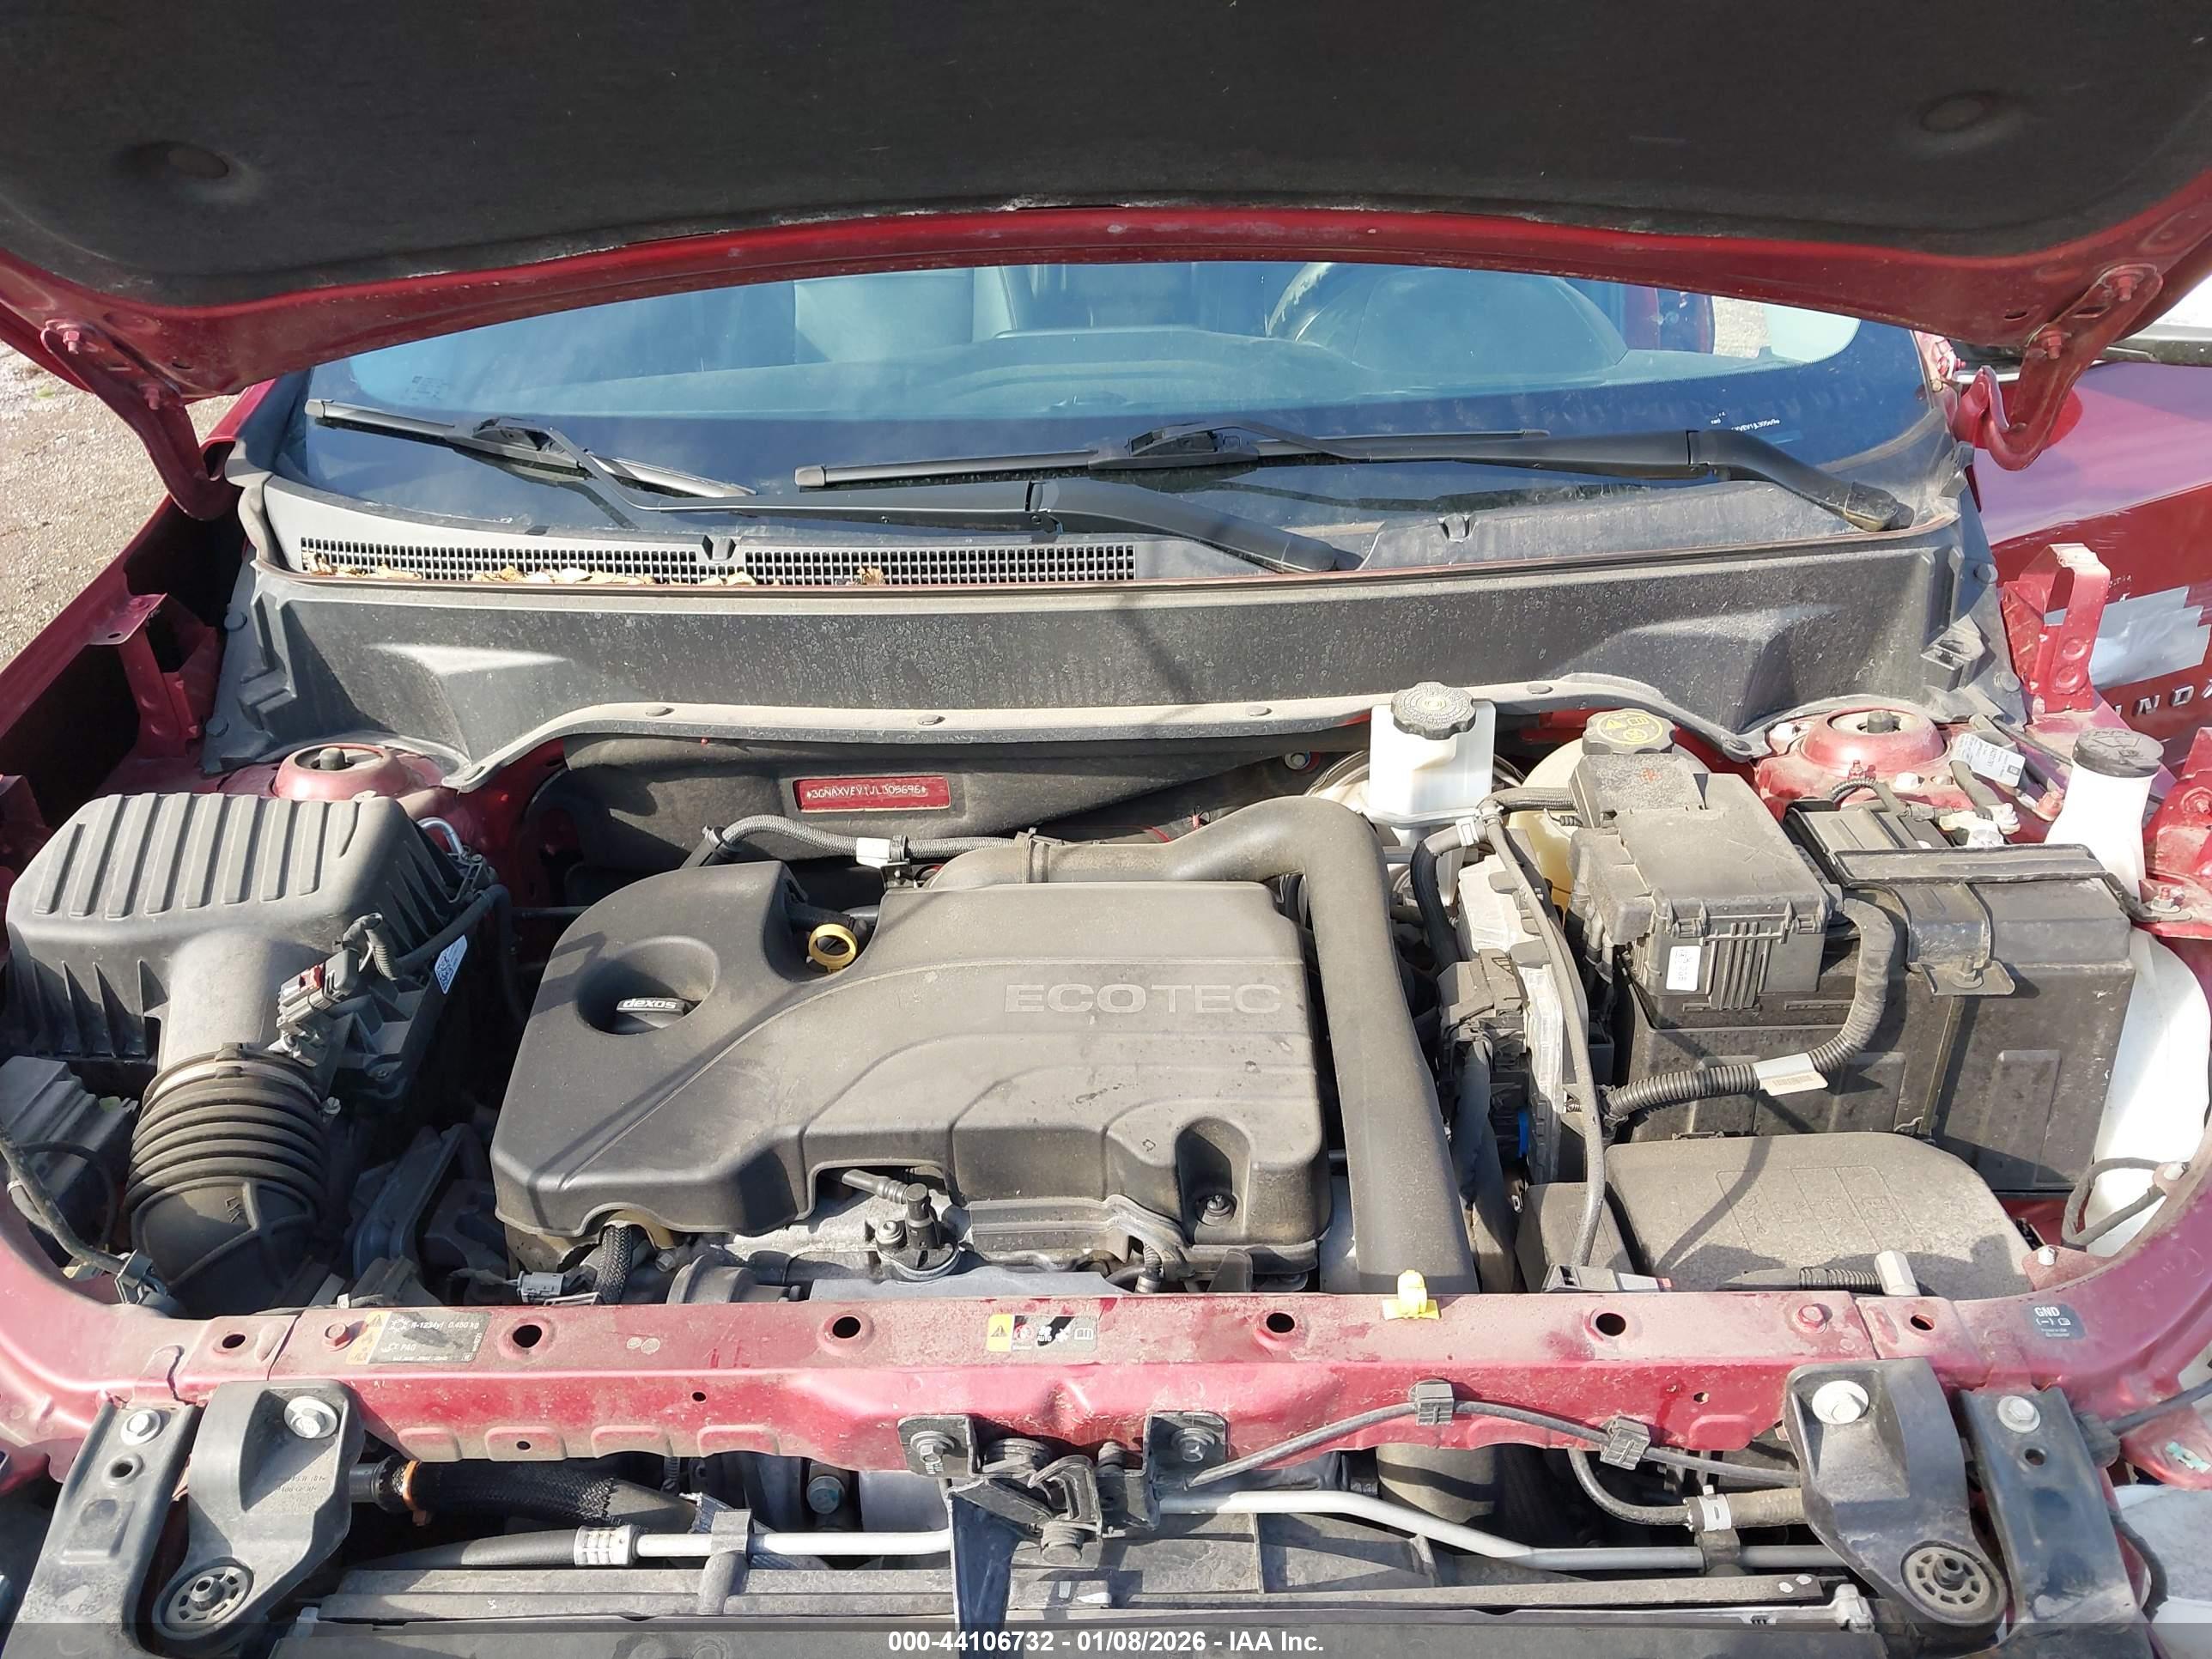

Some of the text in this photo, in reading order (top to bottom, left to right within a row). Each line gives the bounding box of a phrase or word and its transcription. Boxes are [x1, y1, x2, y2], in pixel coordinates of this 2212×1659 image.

[623, 998, 677, 1009] dexos
[1005, 983, 1281, 1013] ECOTEC
[2034, 1306, 2060, 1317] GND
